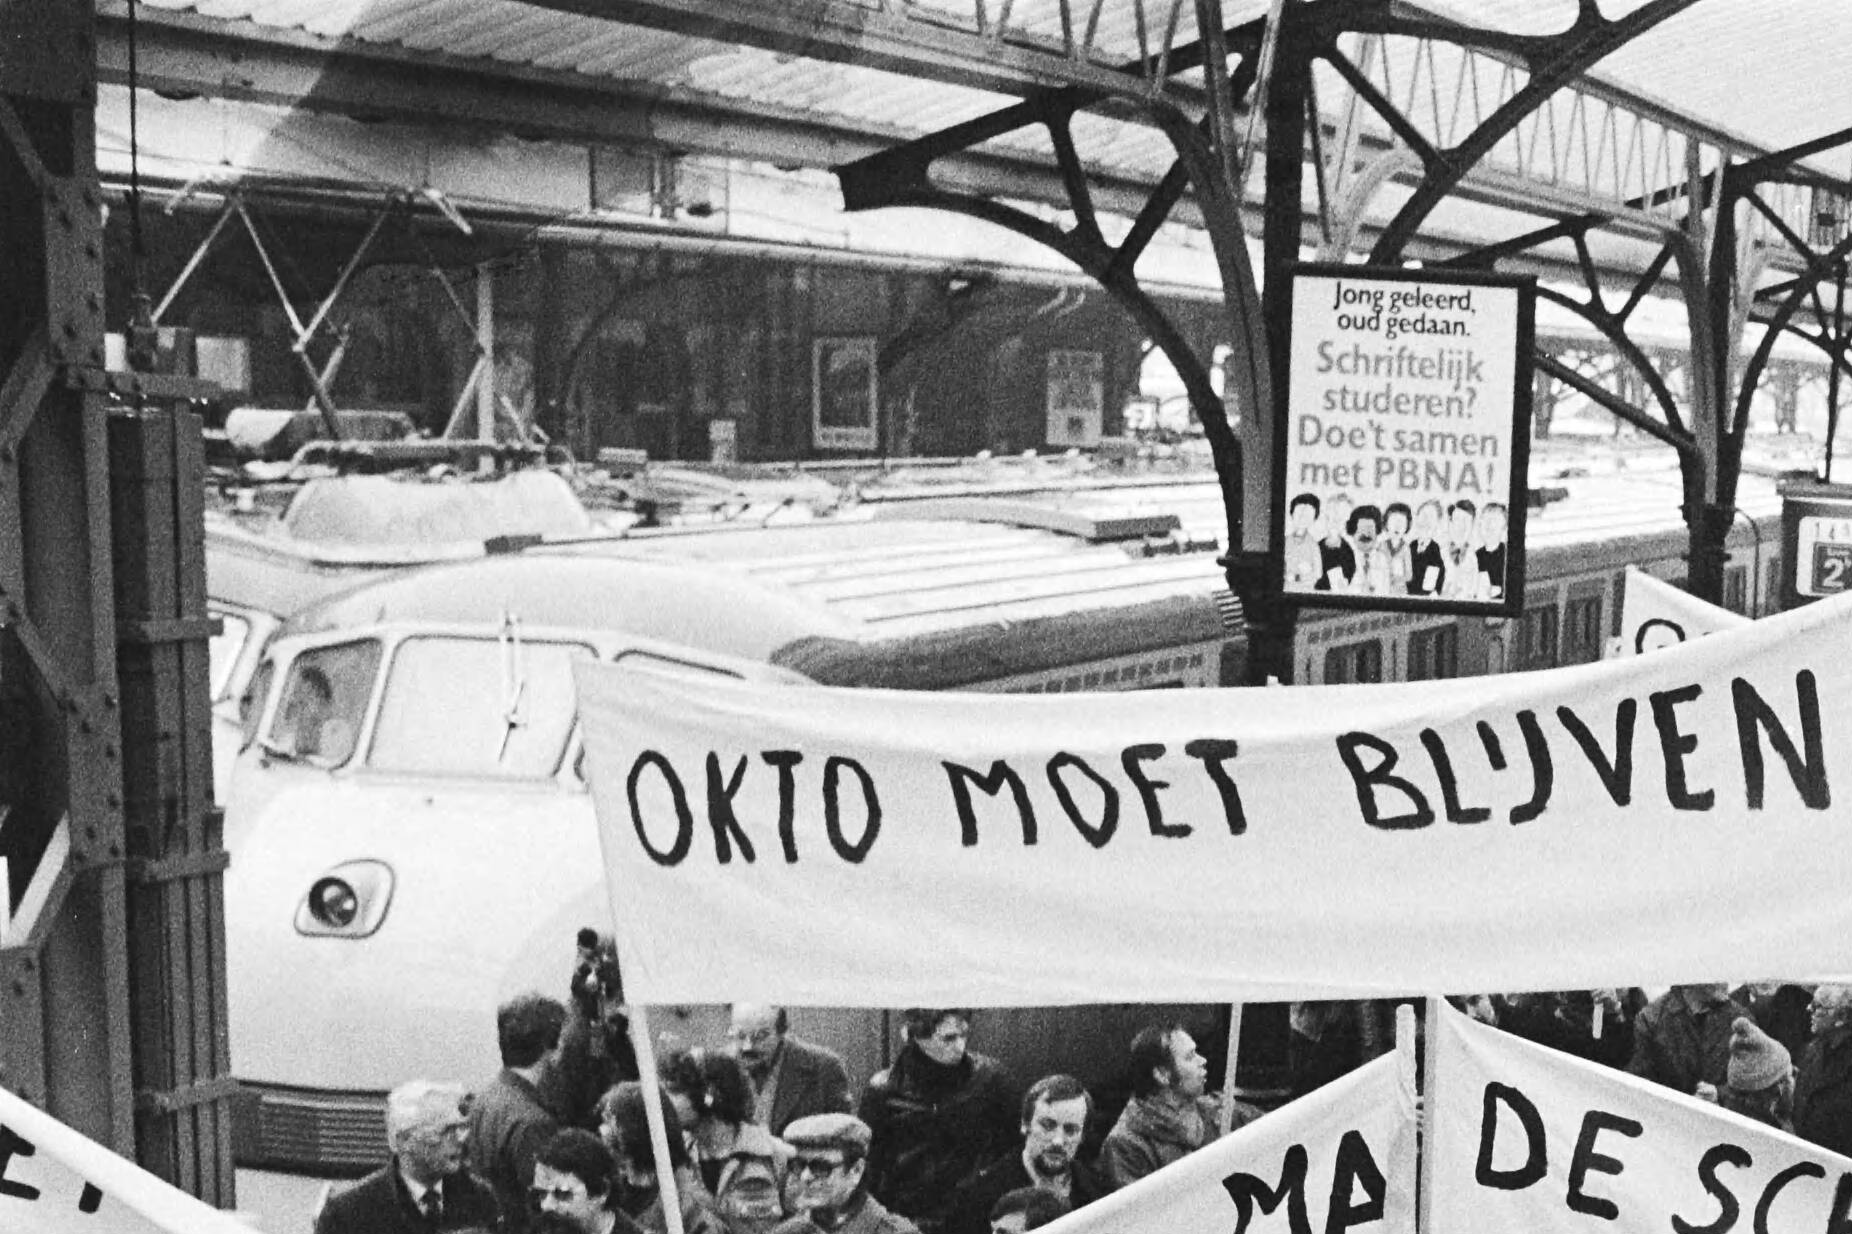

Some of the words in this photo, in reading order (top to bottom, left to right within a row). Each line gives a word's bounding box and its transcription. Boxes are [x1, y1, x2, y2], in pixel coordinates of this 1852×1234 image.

[1333, 281, 1384, 314] Jong
[1388, 286, 1476, 315] geleerd,
[1337, 311, 1380, 331] oud
[1385, 313, 1471, 340] gedaan.
[1316, 340, 1483, 392] Schriftelijk
[1323, 383, 1477, 419] studeren?
[1392, 429, 1499, 457] samen
[1300, 460, 1364, 488] met
[1374, 457, 1494, 494] PBNA!
[627, 749, 883, 866] OKTO
[942, 740, 1249, 848] MOET
[1475, 1080, 1643, 1222] DE
